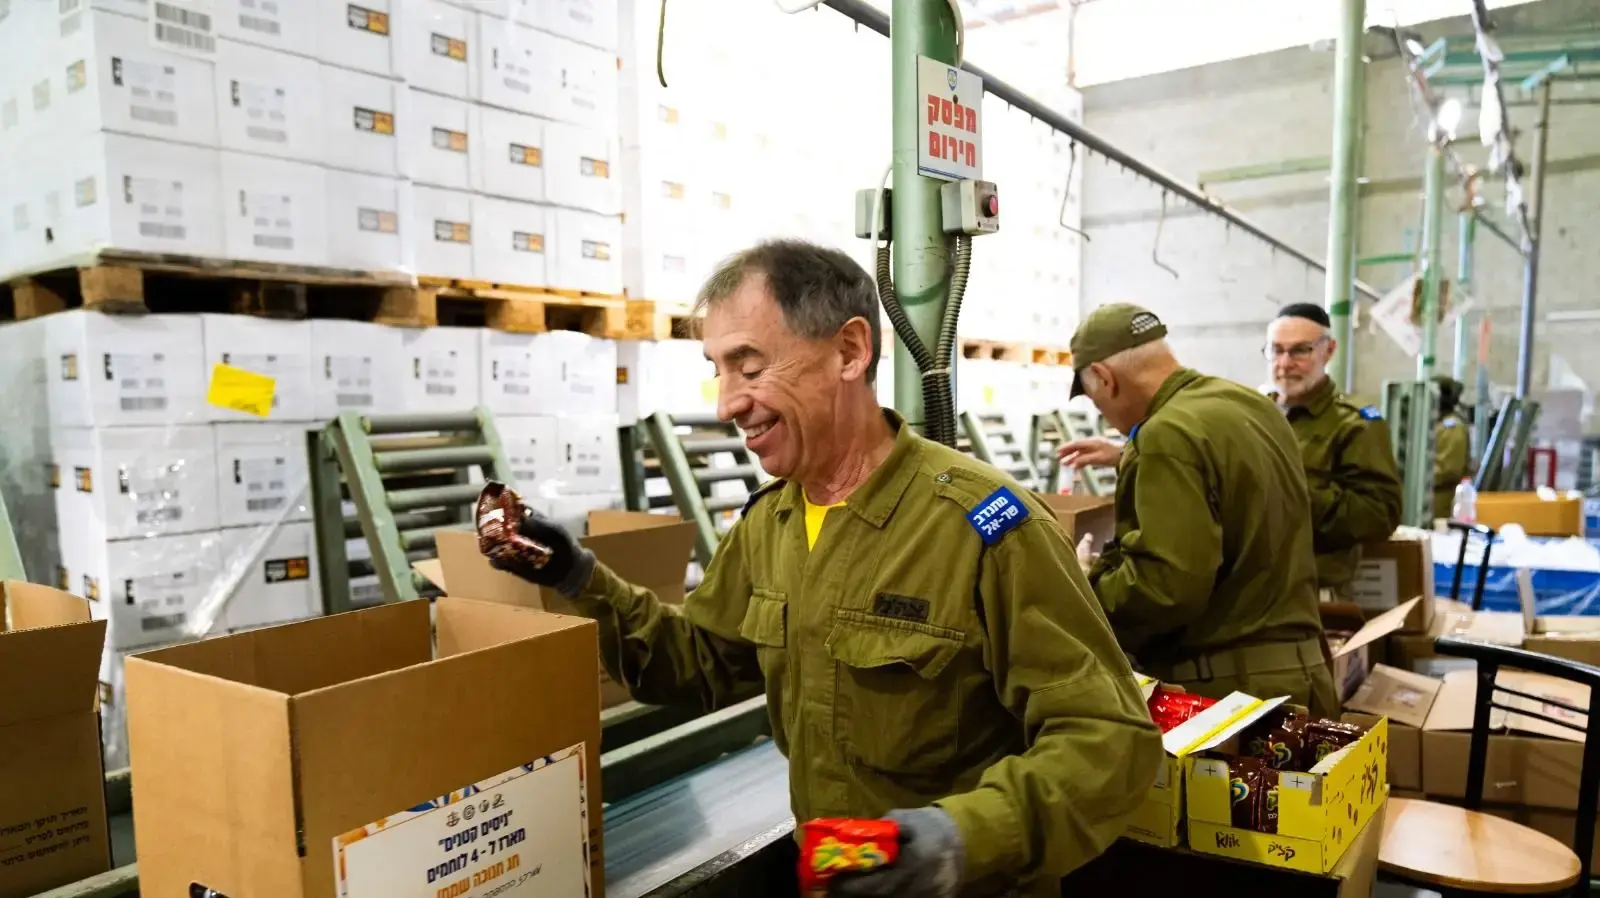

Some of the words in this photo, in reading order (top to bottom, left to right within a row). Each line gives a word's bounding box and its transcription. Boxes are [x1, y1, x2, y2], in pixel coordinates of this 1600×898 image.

[927, 94, 976, 134] מפסק
[928, 130, 976, 168] חירום
[973, 496, 1009, 526] מתנדב
[981, 505, 1019, 535] שר-אל
[498, 827, 526, 853] מארז
[426, 852, 469, 884] לוחמים
[470, 848, 479, 863] 4
[506, 852, 520, 873] חג
[473, 861, 505, 888] חנוכה
